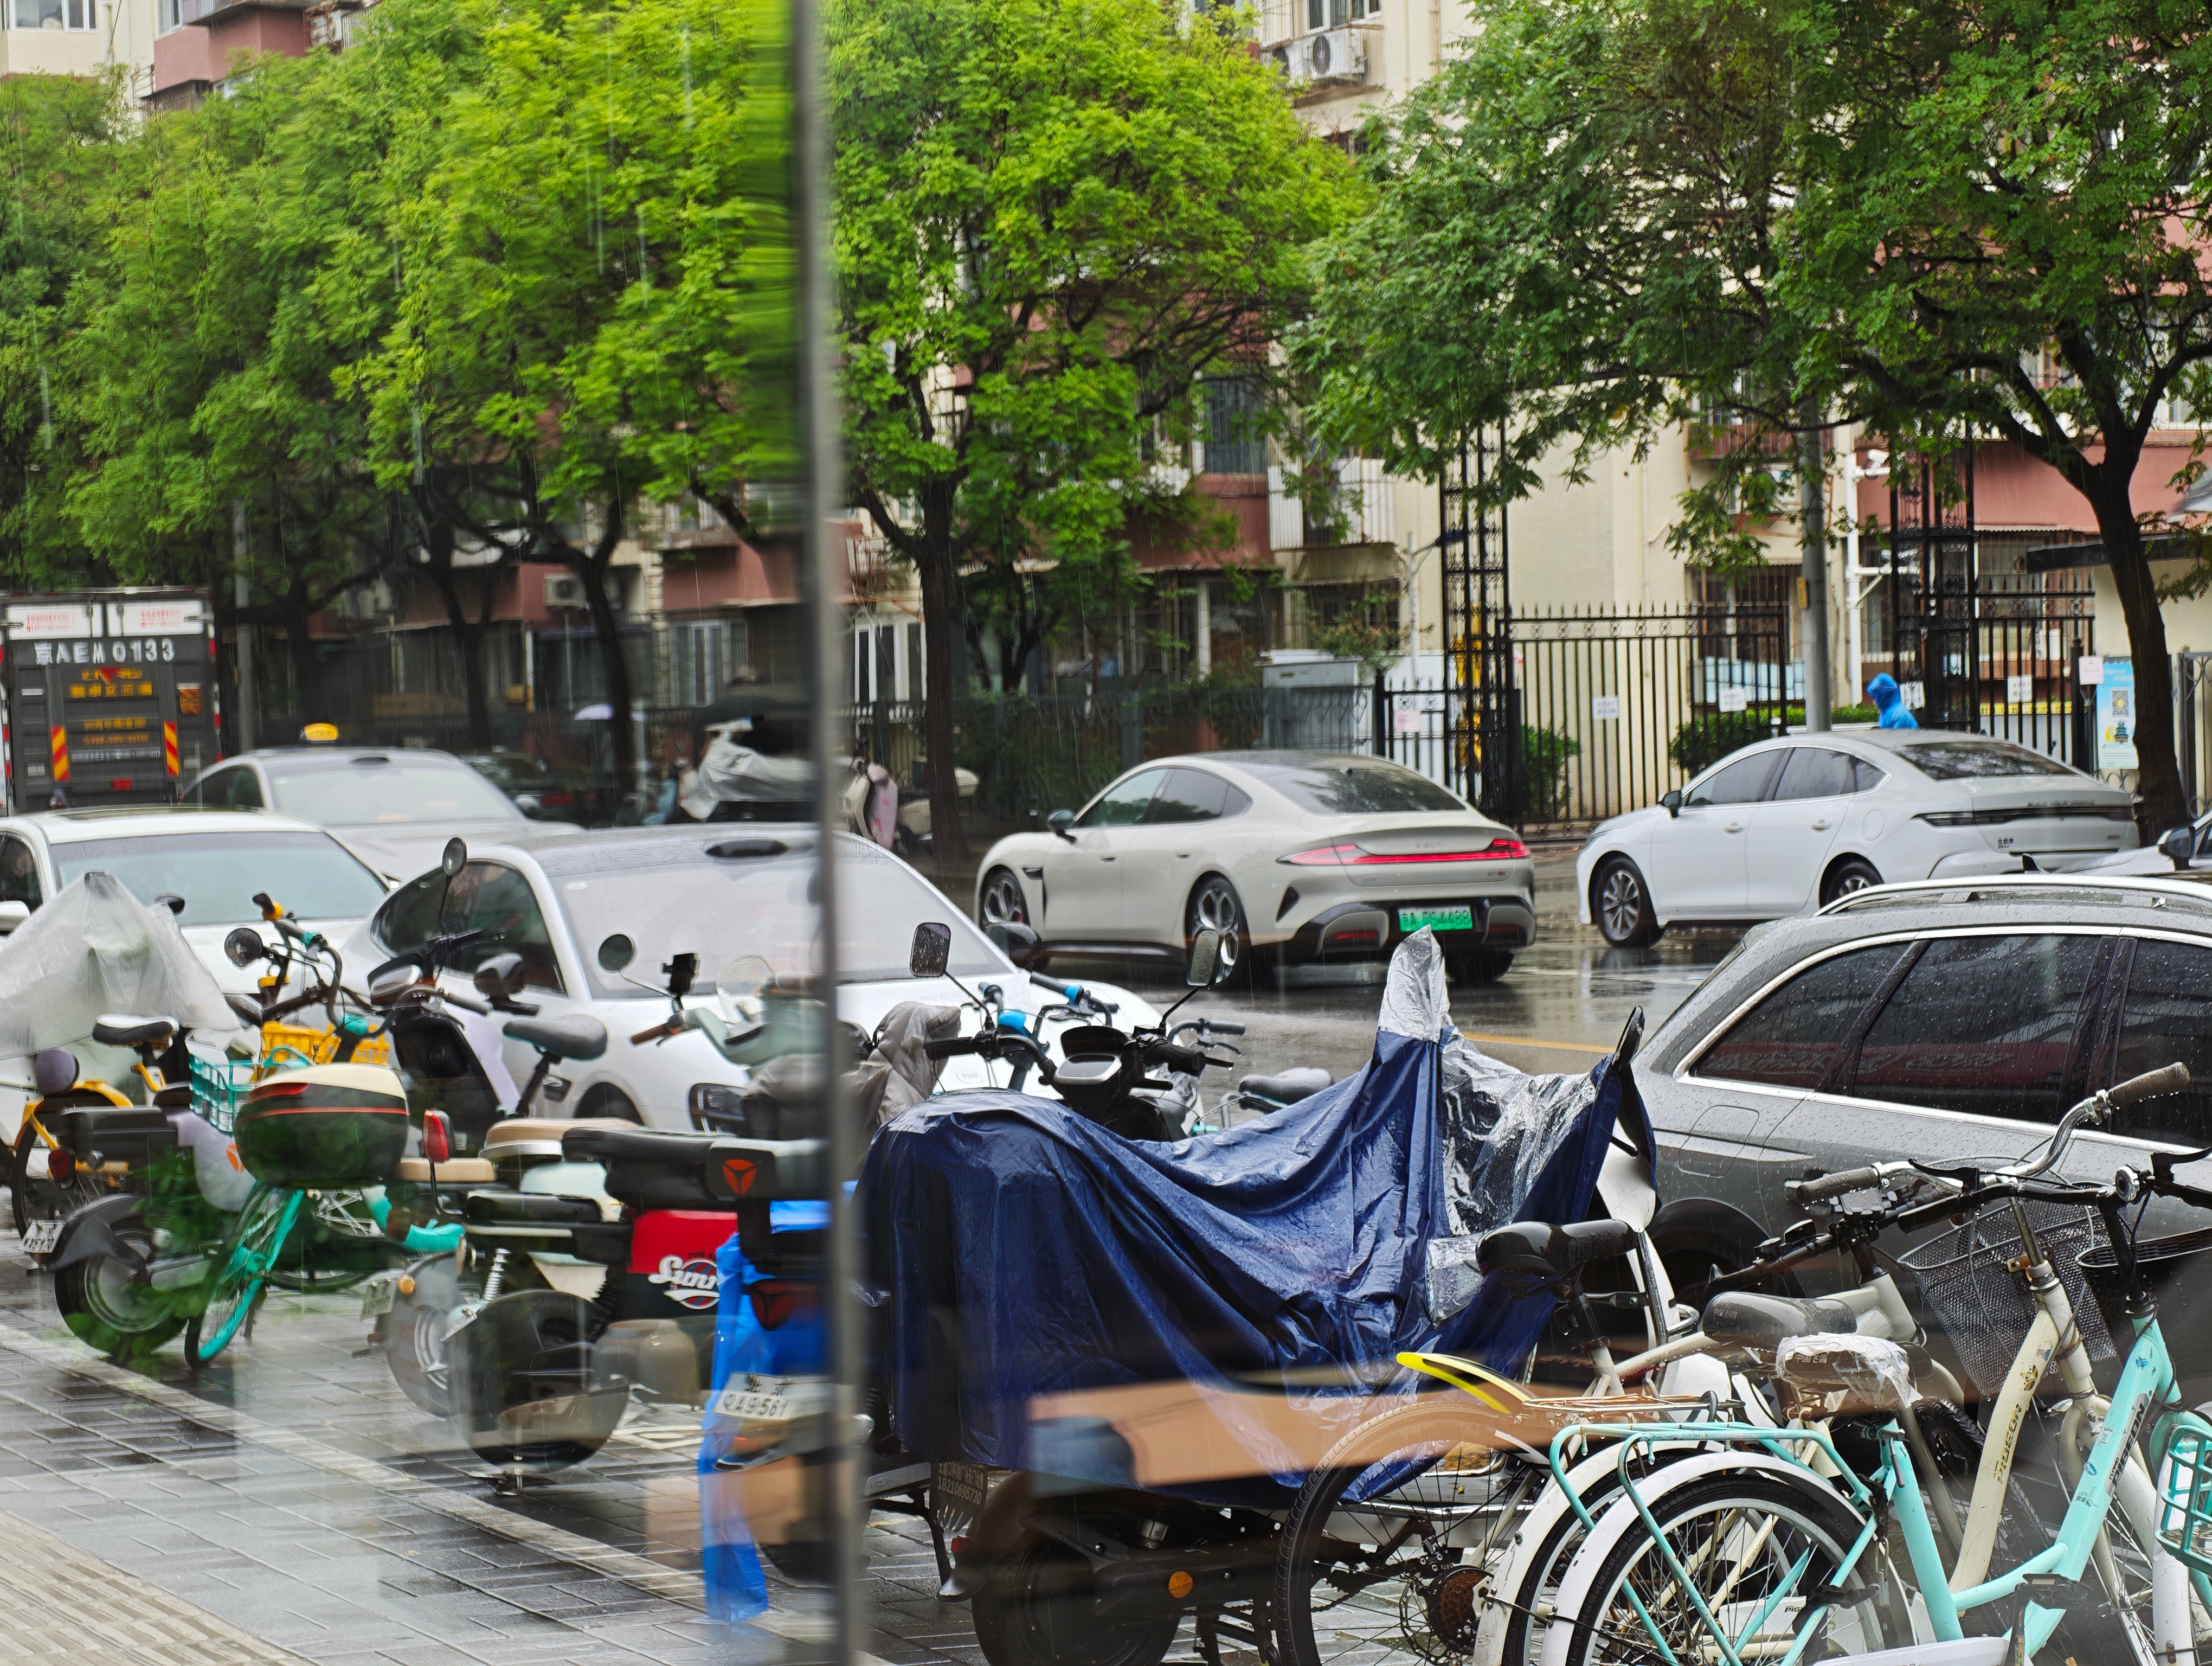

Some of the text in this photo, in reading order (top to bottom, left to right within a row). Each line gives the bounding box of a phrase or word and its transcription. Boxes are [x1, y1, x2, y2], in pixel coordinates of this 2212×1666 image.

[1795, 1354, 1828, 1363] 中国飞鸽
[2112, 1402, 2146, 1490] PIGEON
[937, 1476, 982, 1505] 18210695730
